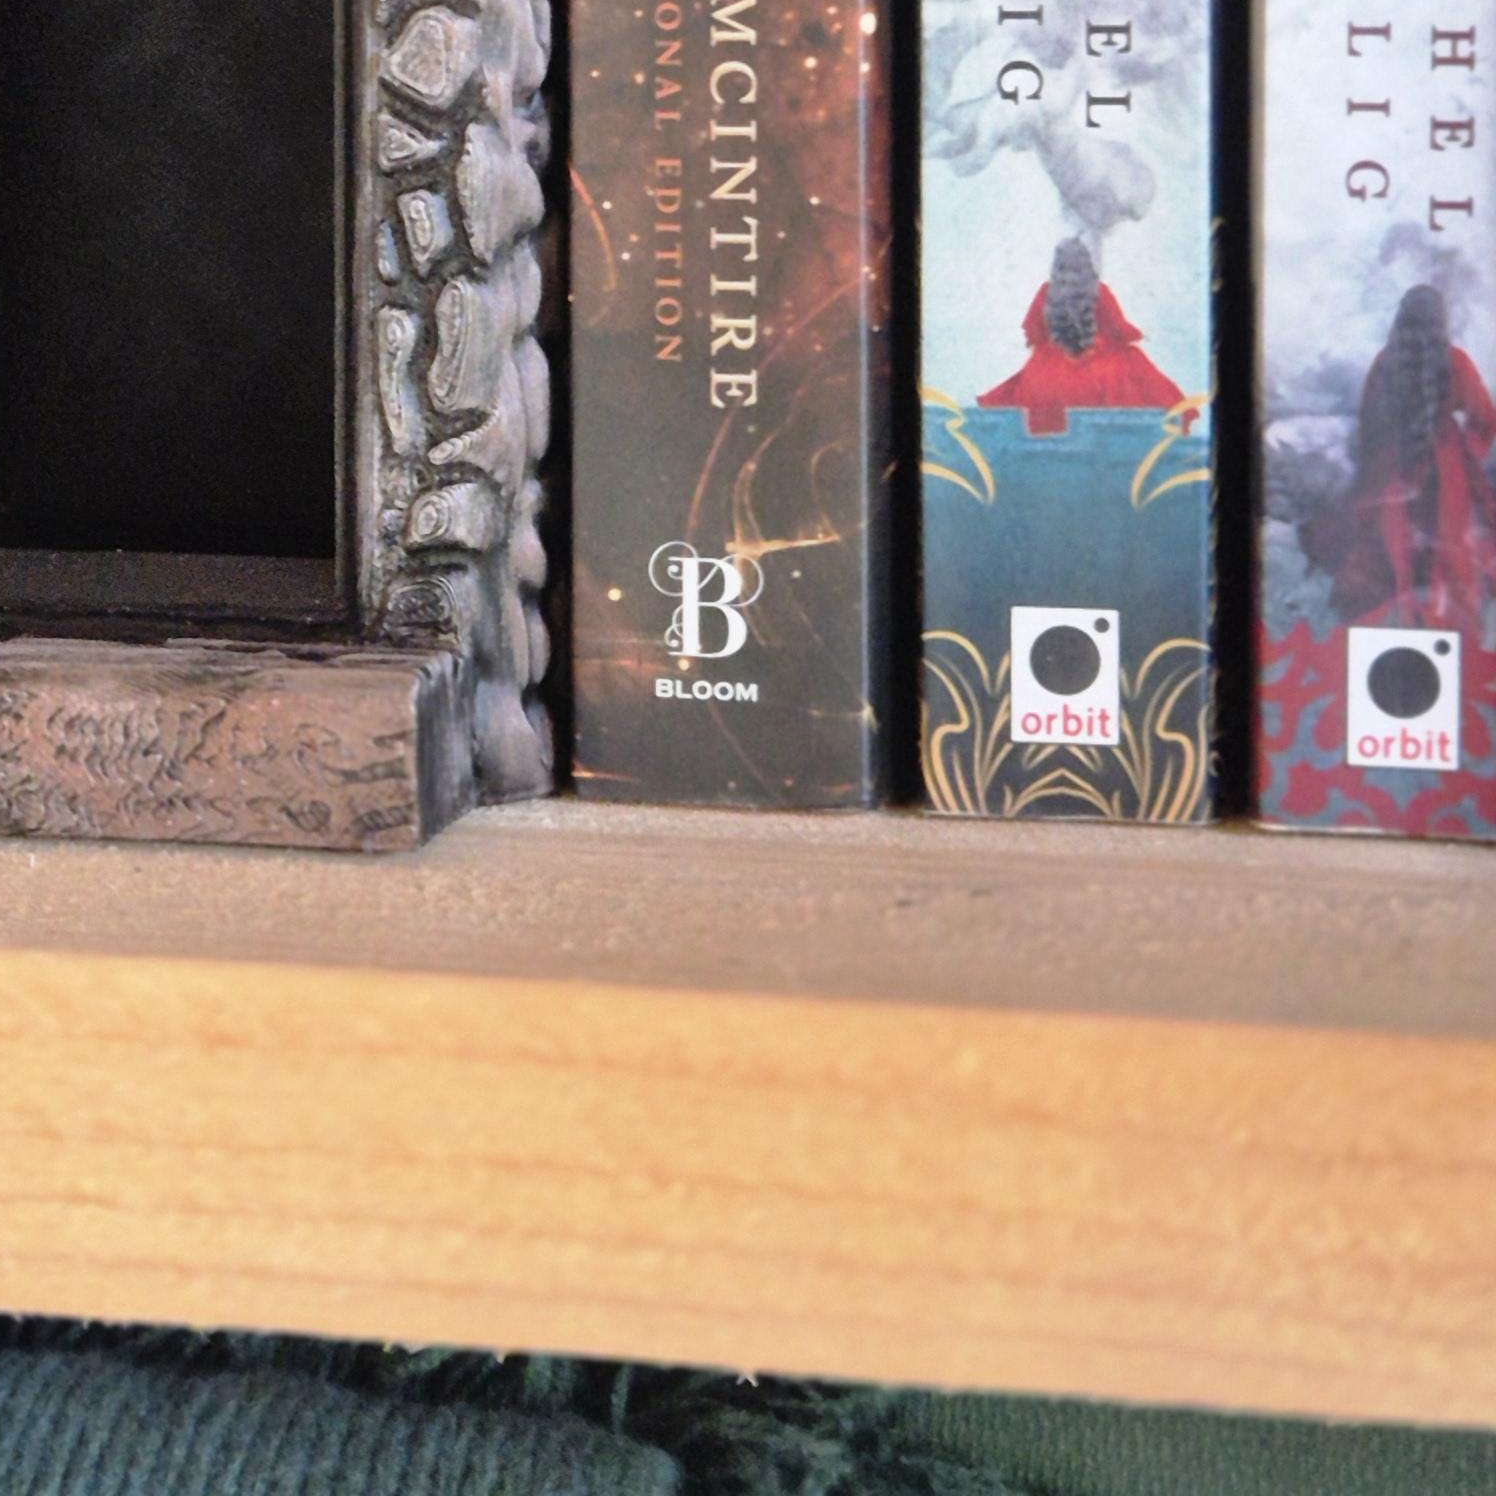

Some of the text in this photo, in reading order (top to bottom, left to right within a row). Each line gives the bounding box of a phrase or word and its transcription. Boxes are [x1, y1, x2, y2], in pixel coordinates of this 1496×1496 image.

[654, 158, 684, 363] EDITION
[654, 677, 759, 703] BLOOM
[1020, 704, 1111, 740] orbit
[1357, 728, 1451, 764] orbit
